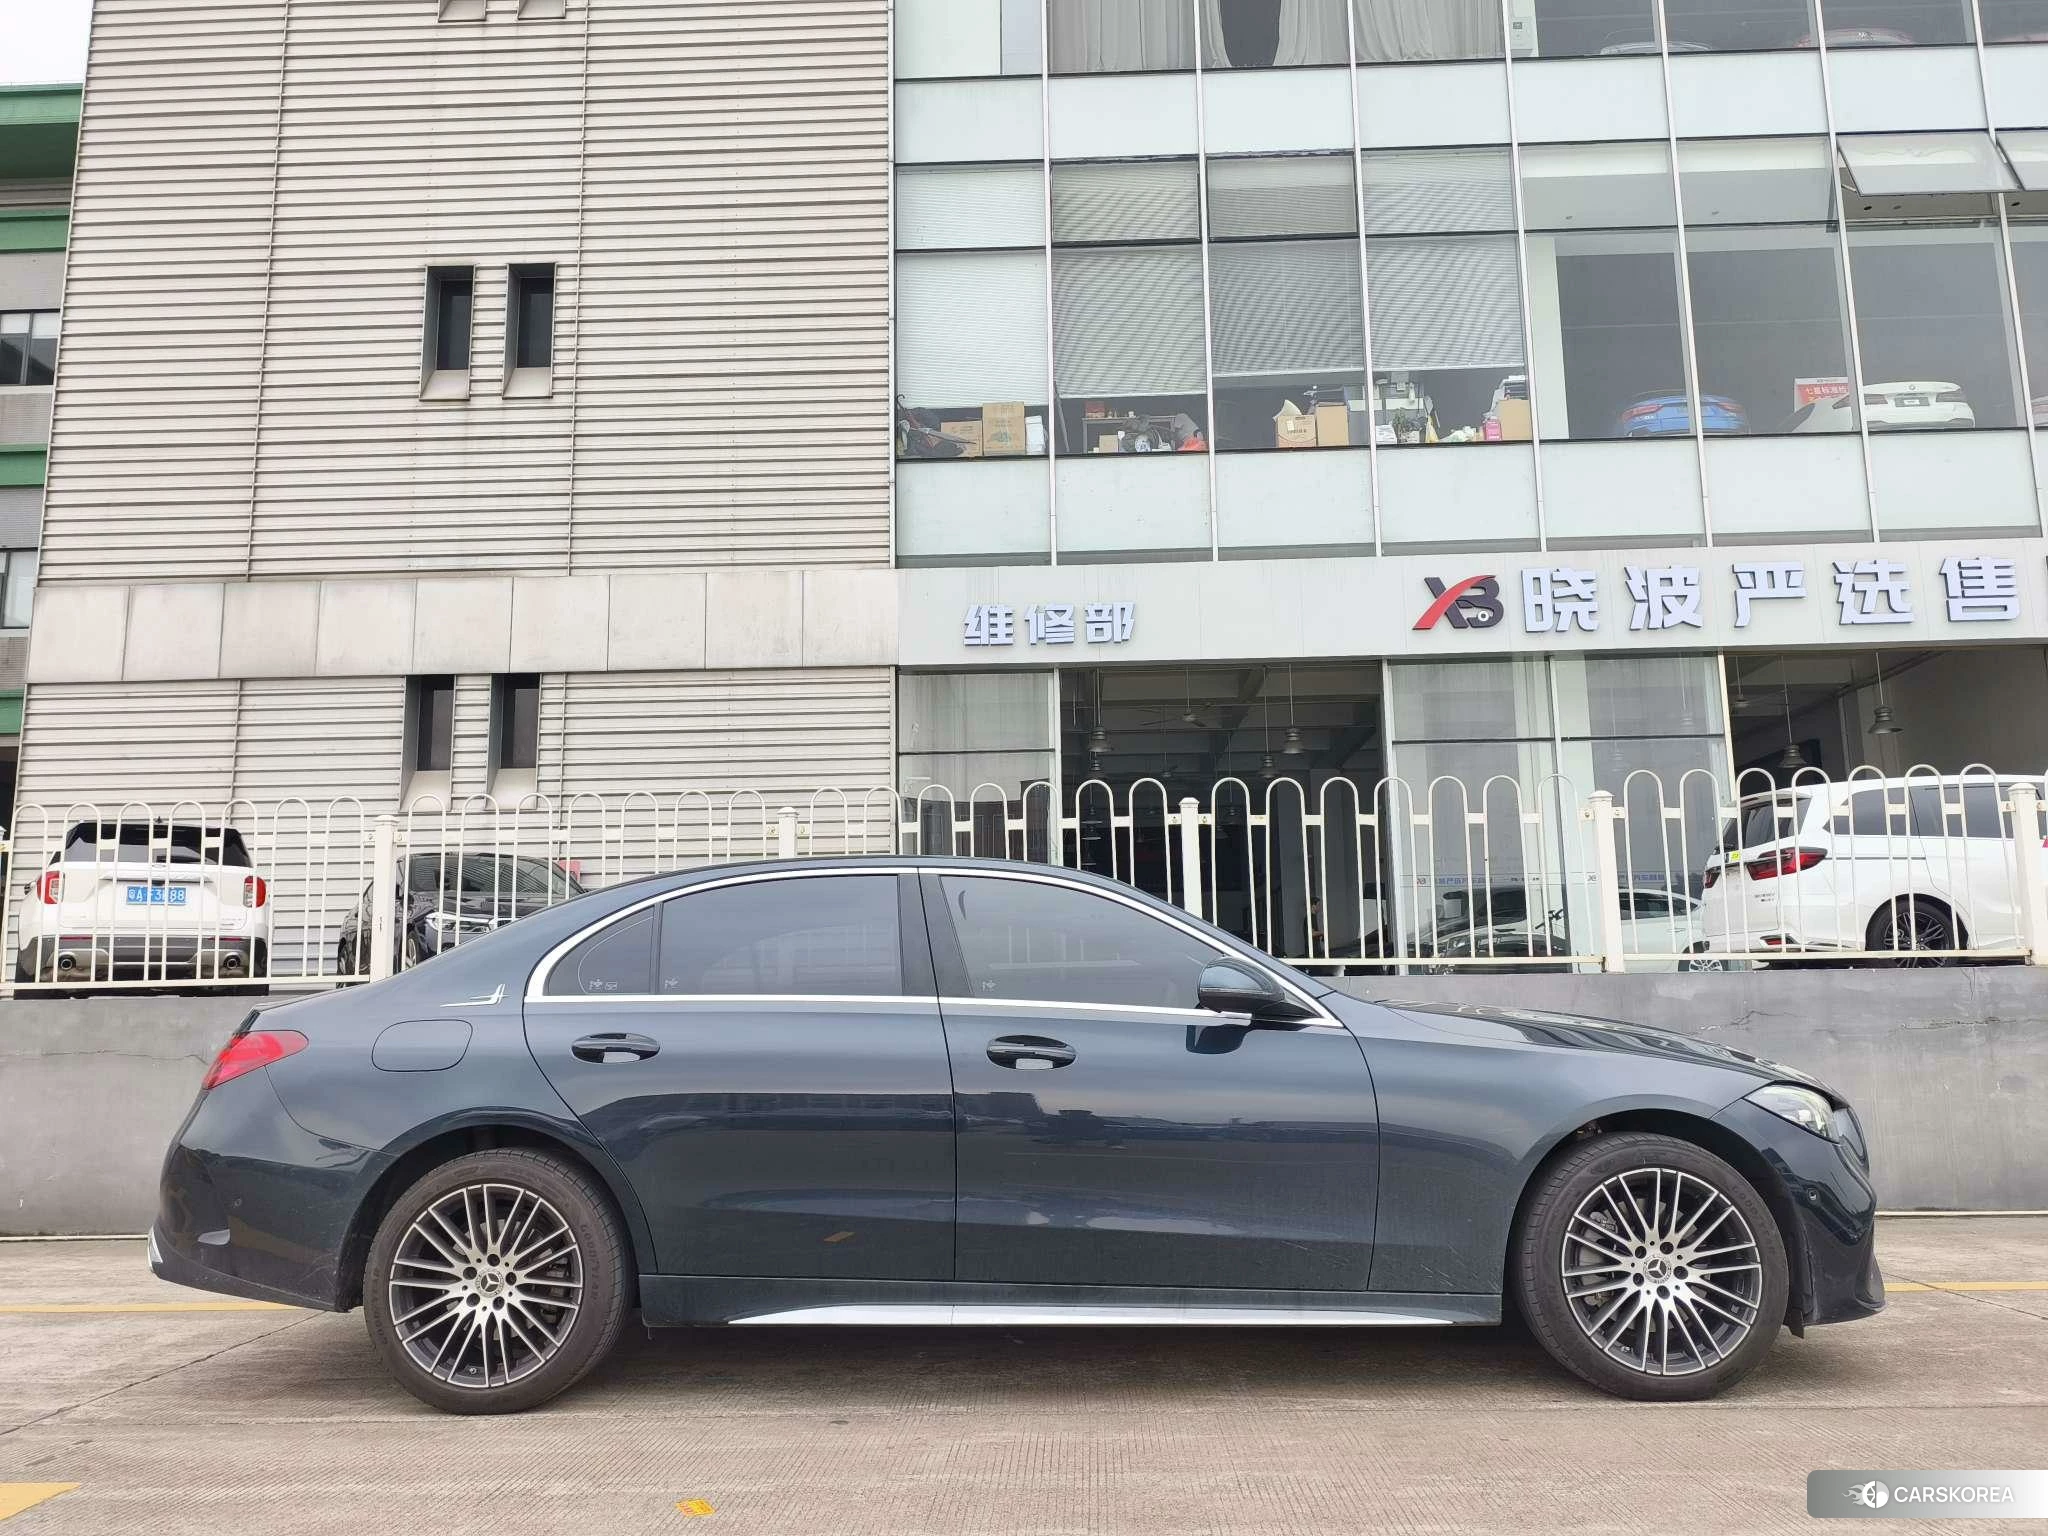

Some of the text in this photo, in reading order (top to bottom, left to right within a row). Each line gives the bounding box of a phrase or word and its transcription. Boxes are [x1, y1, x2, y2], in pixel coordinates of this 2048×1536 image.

[963, 602, 1136, 645] 维修部
[1521, 555, 2048, 633] 晓波严选售
